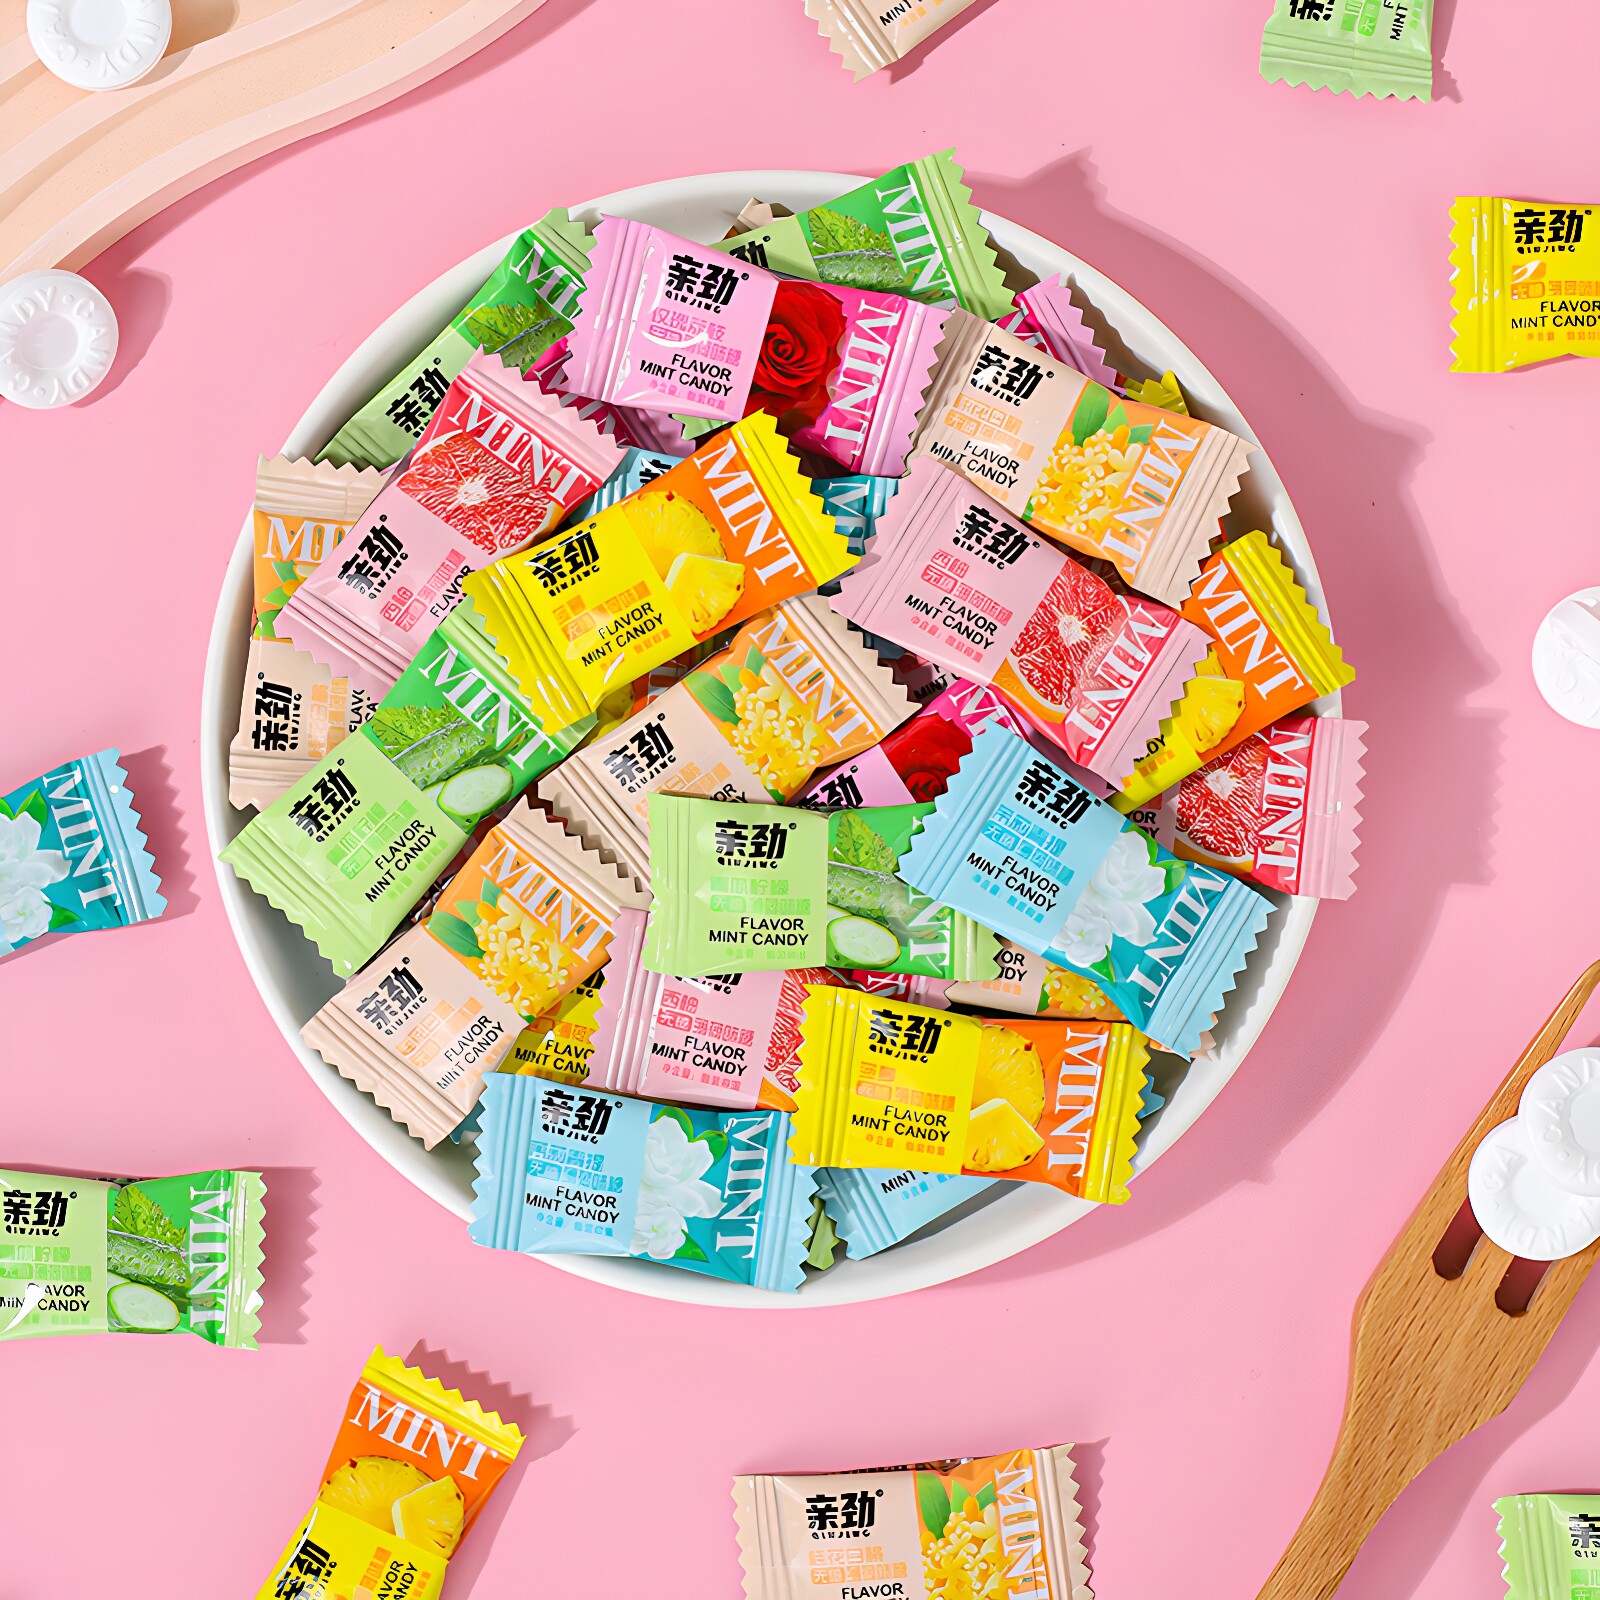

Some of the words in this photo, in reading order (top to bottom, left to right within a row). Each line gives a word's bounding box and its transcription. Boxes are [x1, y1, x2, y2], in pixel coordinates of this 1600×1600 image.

[1511, 316, 1548, 329] MINT
[640, 360, 677, 382] MINT
[679, 371, 733, 398] CANDY
[671, 353, 732, 382] FLAVOR
[823, 299, 903, 457] MINT
[448, 390, 592, 505] MINT
[966, 453, 1018, 489] CANDY
[693, 438, 805, 586] MINT
[1102, 417, 1205, 576] MINT
[582, 642, 613, 667] MINT
[615, 613, 664, 648] CANDY
[904, 594, 943, 619] MINT
[942, 615, 995, 650] CANDY
[940, 596, 998, 636] FLAVOR
[1189, 559, 1304, 700] MINT
[749, 611, 874, 747] MINT
[1064, 603, 1171, 750] MINT
[418, 641, 556, 770] MINT
[1256, 726, 1312, 881] MINT
[43, 765, 122, 909] MINT
[365, 869, 397, 902] MINT
[395, 826, 438, 872] CANDY
[374, 819, 425, 870] FLAVOR
[481, 840, 617, 963] MINT
[966, 852, 1005, 879] MINT
[1005, 876, 1056, 912] CANDY
[1001, 855, 1060, 898] FLAVOR
[709, 930, 748, 944] MINT
[752, 933, 808, 946] CANDY
[740, 917, 804, 931] FLAVOR
[1126, 863, 1229, 1008] MINT
[444, 1015, 492, 1062] FLAVOR
[464, 1021, 505, 1064] CANDY
[652, 1042, 690, 1063] MINT
[692, 1054, 747, 1077] CANDY
[684, 1036, 746, 1061] FLAVOR
[852, 1114, 891, 1131] MINT
[894, 1123, 950, 1142] CANDY
[885, 1105, 947, 1127] FLAVOR
[1047, 1027, 1109, 1177] MINT
[526, 1192, 562, 1212] MINT
[565, 1204, 620, 1224] CANDY
[556, 1185, 617, 1209] FLAVOR
[715, 1113, 775, 1259] MINT
[188, 1186, 232, 1333] MINT
[37, 1300, 90, 1312] CANDY
[349, 1383, 499, 1480] MINT
[841, 1582, 904, 1600] FLAVOR
